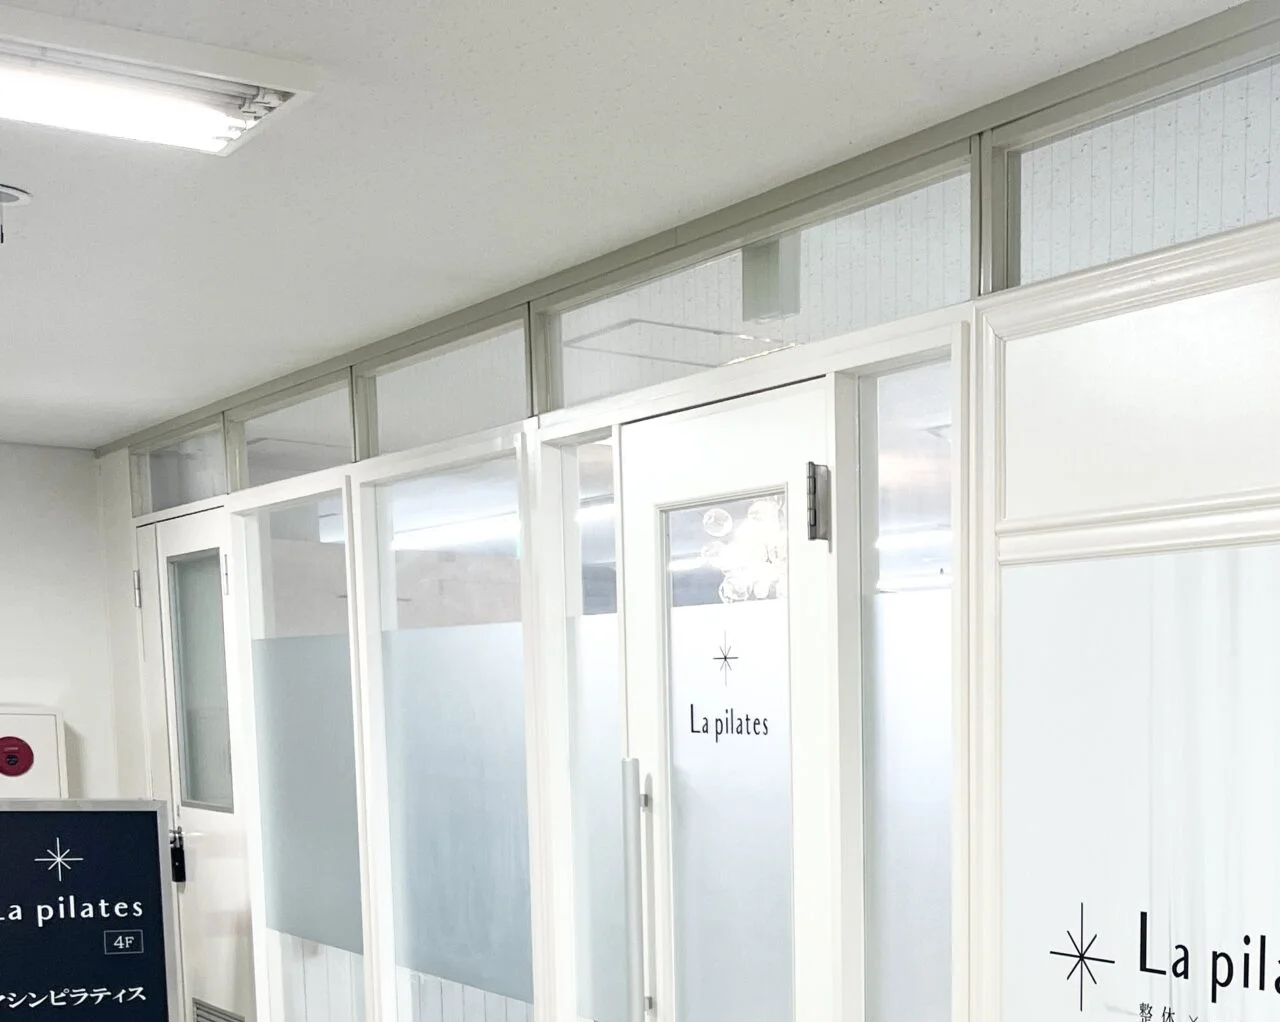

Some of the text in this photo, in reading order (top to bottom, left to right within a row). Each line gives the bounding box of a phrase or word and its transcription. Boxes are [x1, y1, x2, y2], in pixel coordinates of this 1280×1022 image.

[690, 703, 769, 743] La pilates
[37, 895, 143, 928] pilates
[113, 935, 135, 949] 4F
[1139, 911, 1189, 980] La
